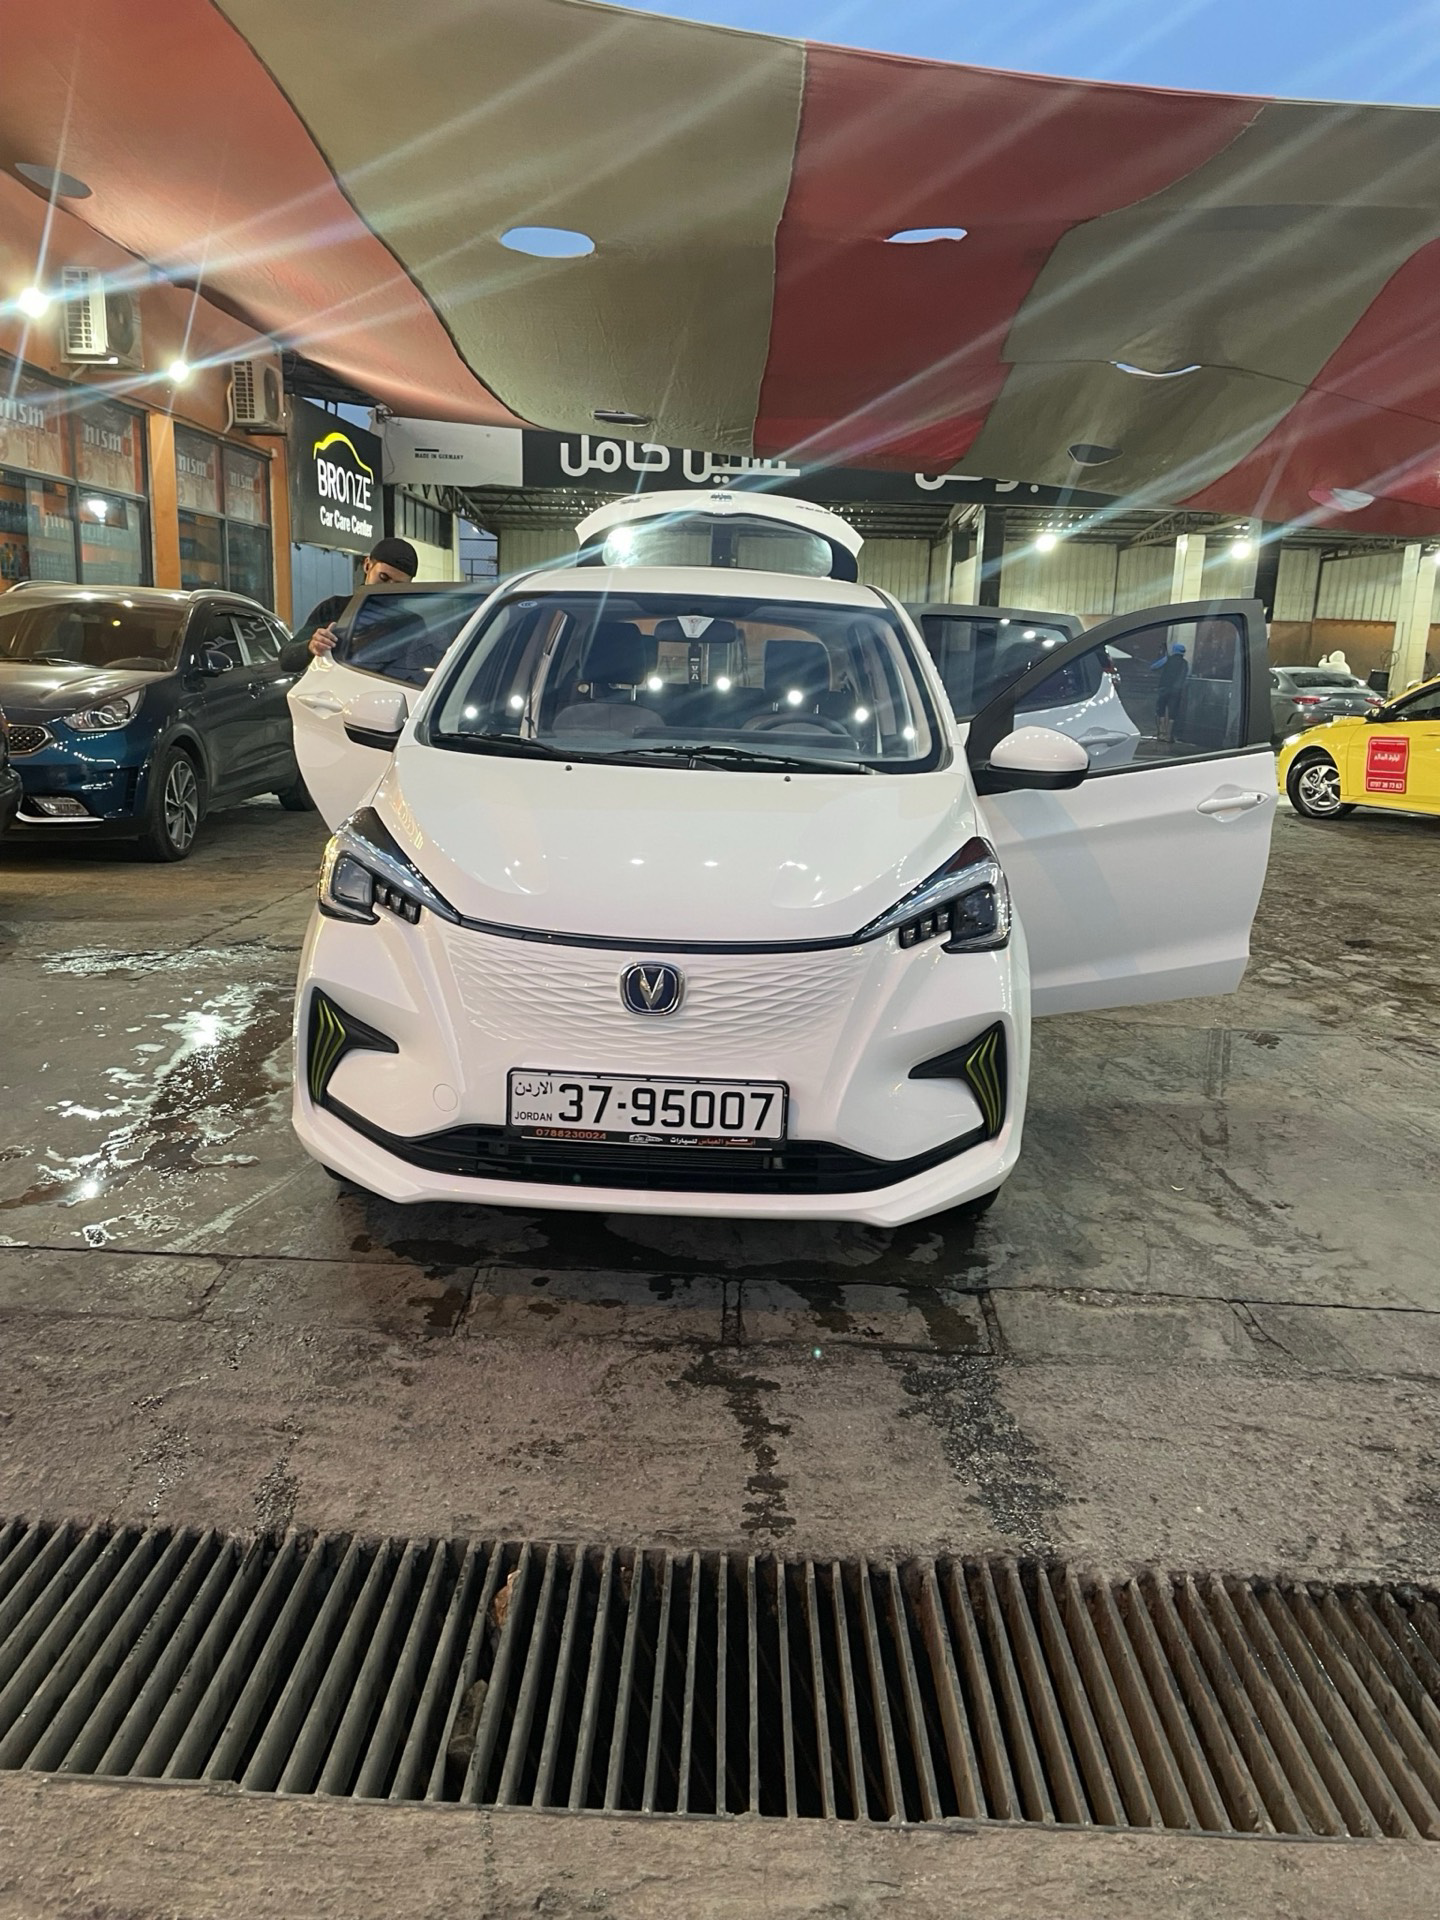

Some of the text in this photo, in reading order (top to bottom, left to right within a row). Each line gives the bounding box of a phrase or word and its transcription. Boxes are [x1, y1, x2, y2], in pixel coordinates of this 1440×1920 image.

[320, 505, 373, 538] Car Care Center
[515, 1081, 552, 1097] الاردن
[514, 1111, 552, 1122] JORDAN
[535, 1128, 607, 1140] 0788230024
[670, 1136, 697, 1146] للسيارات
